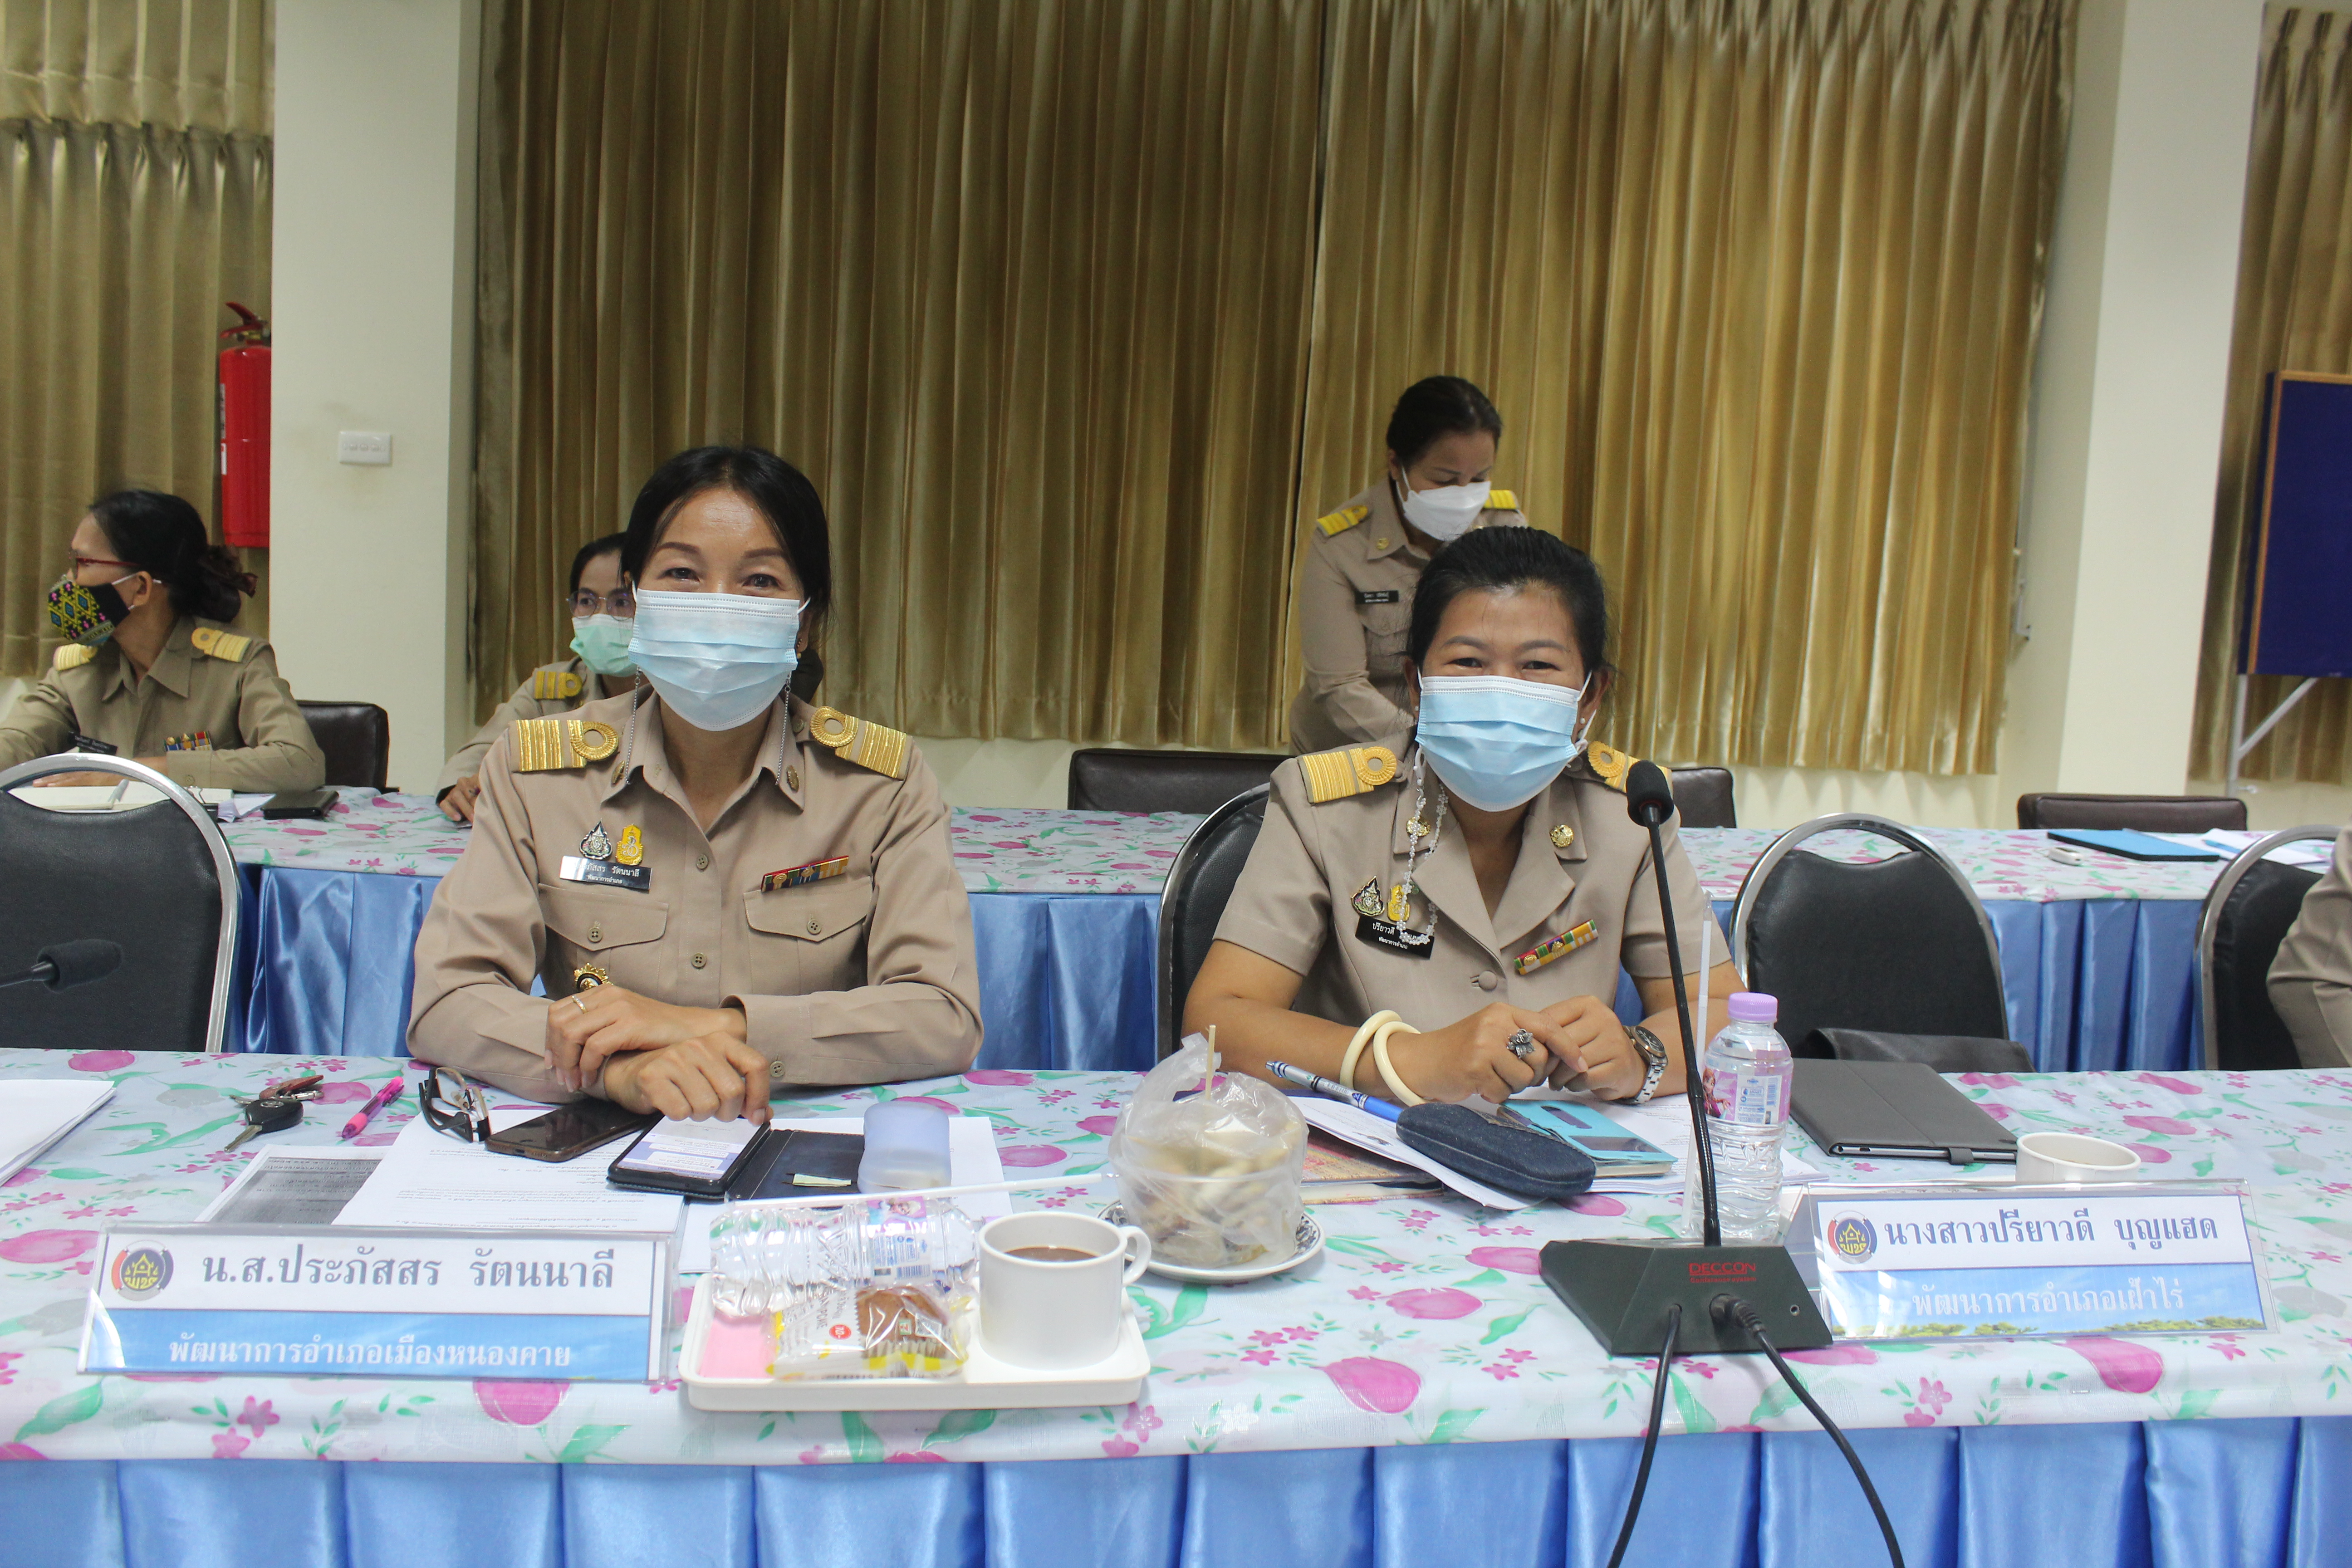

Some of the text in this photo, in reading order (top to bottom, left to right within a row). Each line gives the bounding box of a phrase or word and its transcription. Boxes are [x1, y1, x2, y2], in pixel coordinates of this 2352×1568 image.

[611, 866, 640, 877] รัตนนาลี
[1372, 922, 1395, 935] ปรียาวดี
[1884, 1208, 2218, 1250] นางสาวปรียาวดี บุญแฮด
[203, 1244, 614, 1288] น.ส.ประภัสสร รัตนนาลี
[1688, 1262, 1756, 1274] DECCON
[1913, 1276, 2184, 1315] พัฒนาการอำเภอเฝ้าไร่
[169, 1332, 571, 1367] พัฒนาการอำเภอเมืองหนองคาย
